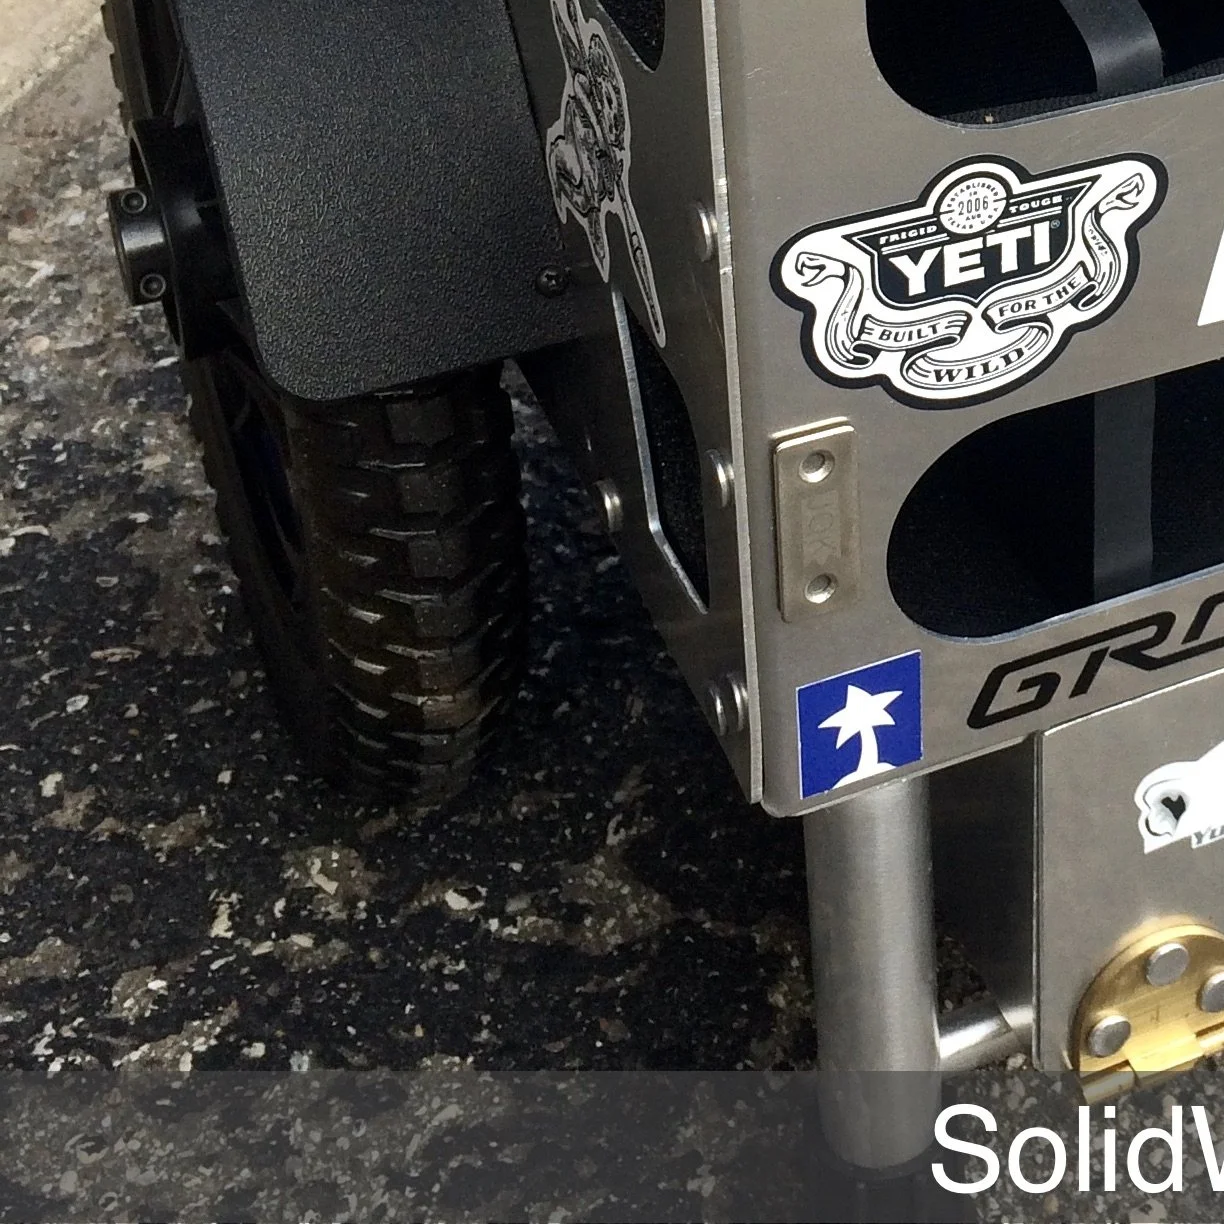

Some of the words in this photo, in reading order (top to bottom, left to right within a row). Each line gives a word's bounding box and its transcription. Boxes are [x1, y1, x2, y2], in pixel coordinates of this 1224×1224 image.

[958, 195, 989, 216] 2006
[888, 220, 1051, 297] YETI
[999, 298, 1037, 317] FOR
[1042, 276, 1083, 306] THE
[878, 322, 943, 343] BUILT
[933, 347, 1026, 383] WILD
